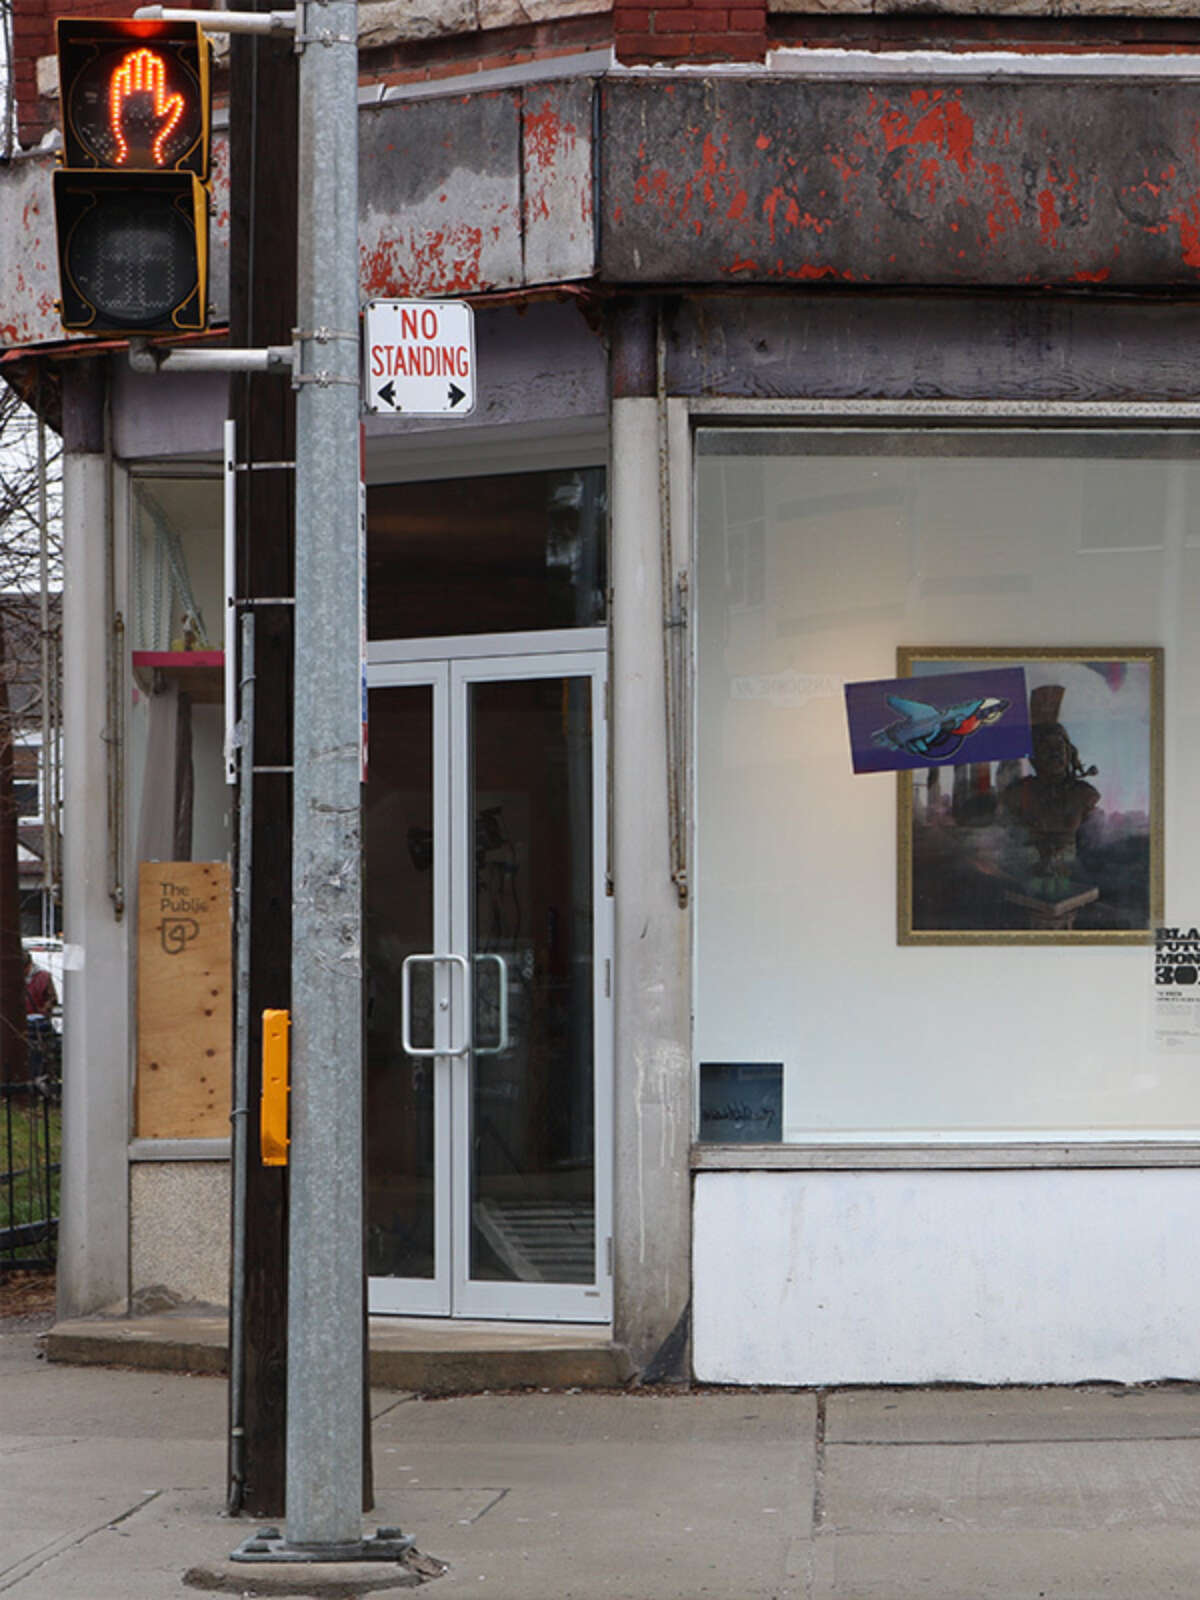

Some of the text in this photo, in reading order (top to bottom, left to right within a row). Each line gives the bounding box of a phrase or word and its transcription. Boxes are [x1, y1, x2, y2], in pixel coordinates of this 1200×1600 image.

[401, 309, 438, 340] NO
[371, 345, 469, 377] STANDING
[160, 882, 190, 896] The
[160, 898, 208, 912] Public
